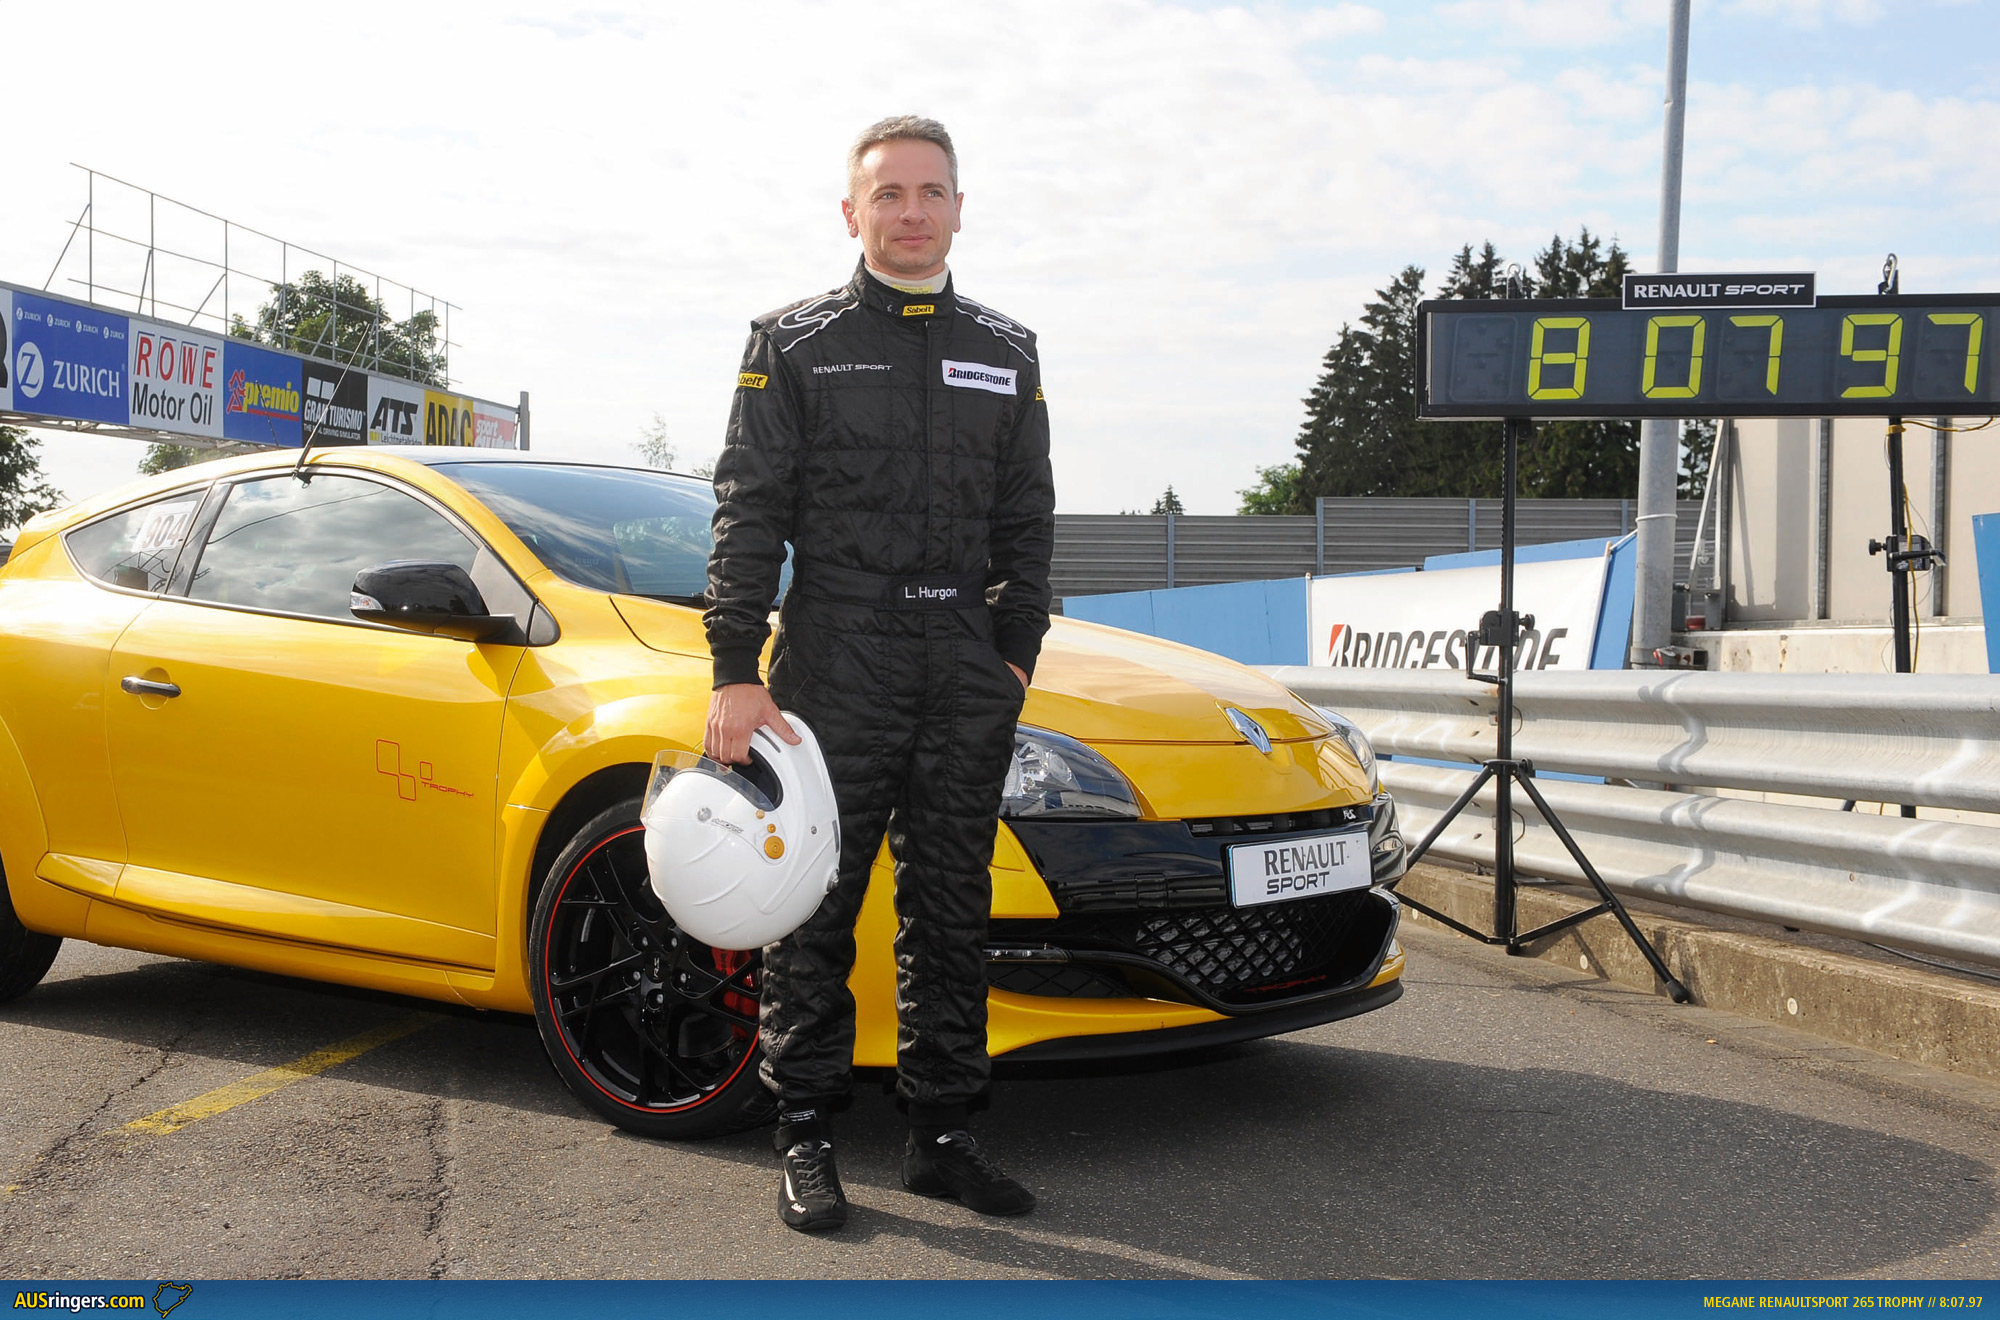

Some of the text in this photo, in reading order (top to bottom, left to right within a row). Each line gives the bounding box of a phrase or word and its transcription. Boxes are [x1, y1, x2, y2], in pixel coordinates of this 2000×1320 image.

[1634, 283, 1805, 298] RENAULT SPORT
[136, 335, 216, 389] ROWE
[812, 363, 893, 375] RENAULT SPORT
[1527, 317, 1591, 400] 8
[52, 360, 120, 398] ZURICH
[739, 374, 765, 387] belt
[948, 367, 1011, 387] BRIDGESTONE
[132, 382, 213, 426] Motor Oil
[242, 381, 300, 413] premio
[304, 399, 329, 425] GRAN
[370, 396, 419, 436] ATS
[426, 402, 472, 447] ADAC
[905, 586, 957, 600] L. Hurgon
[1328, 624, 1568, 670] BRIDGESNE
[421, 781, 474, 797] TROPHY
[1264, 840, 1346, 876] RENAULT
[1266, 871, 1330, 895] SPORT
